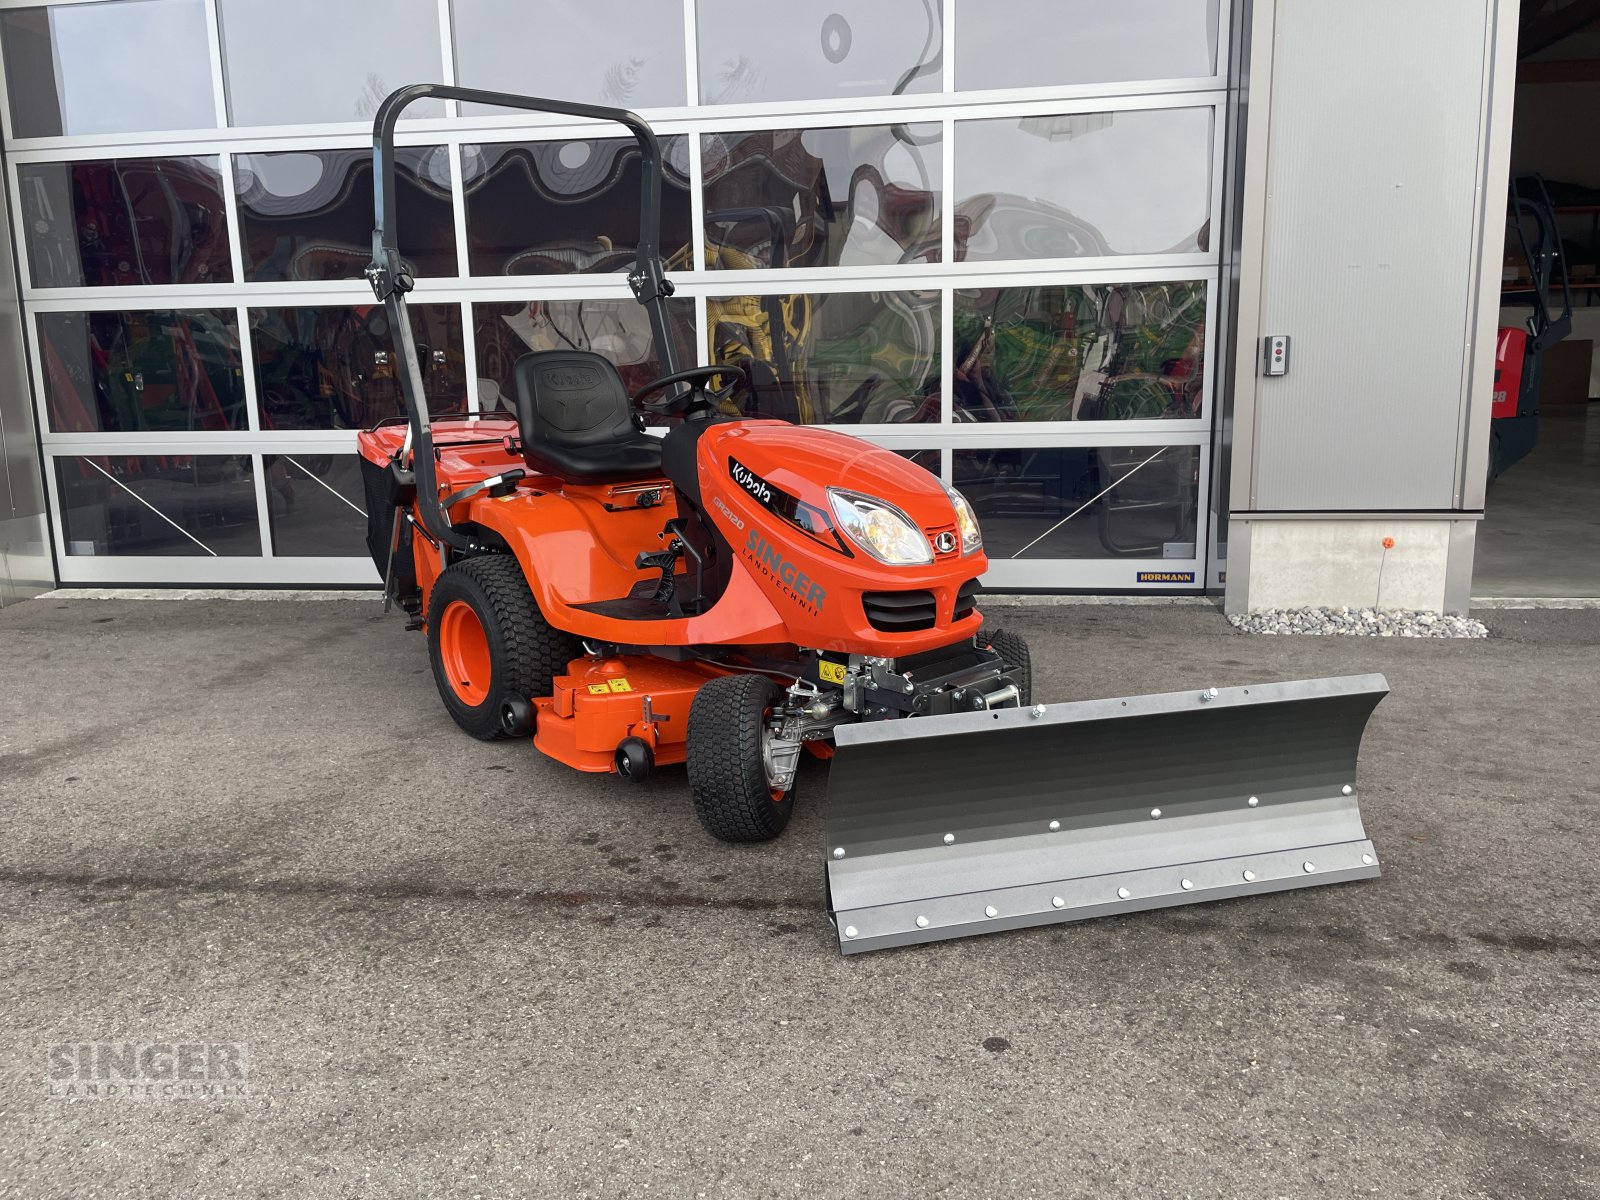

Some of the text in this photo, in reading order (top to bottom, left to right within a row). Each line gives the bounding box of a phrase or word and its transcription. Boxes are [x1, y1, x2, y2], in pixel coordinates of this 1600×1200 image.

[732, 462, 771, 503] Kubota
[713, 496, 745, 530] GR2120
[745, 529, 827, 611] SINGER
